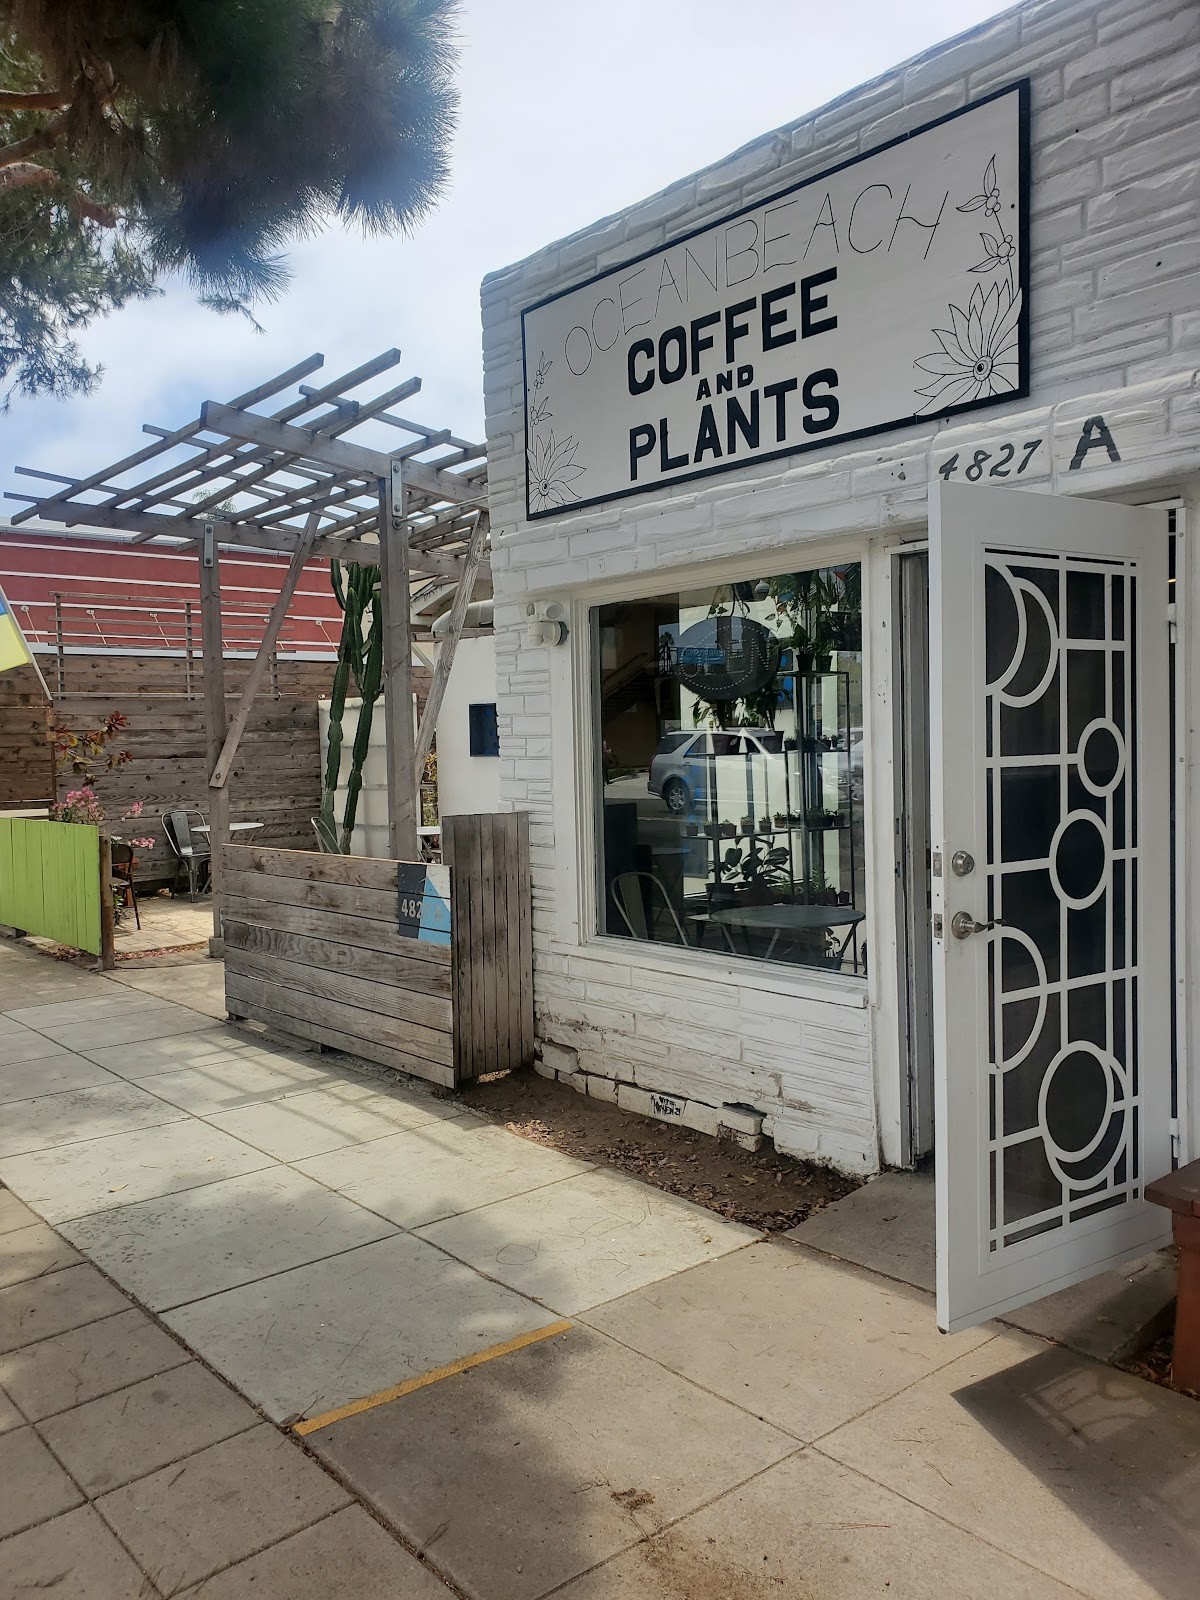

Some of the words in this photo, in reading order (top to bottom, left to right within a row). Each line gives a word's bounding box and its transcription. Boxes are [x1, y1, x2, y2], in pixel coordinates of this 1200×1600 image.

[627, 266, 838, 396] COFFEE
[629, 367, 840, 482] PLANTS
[695, 363, 754, 402] AND
[938, 439, 1043, 482] 4827
[1068, 415, 1122, 471] A
